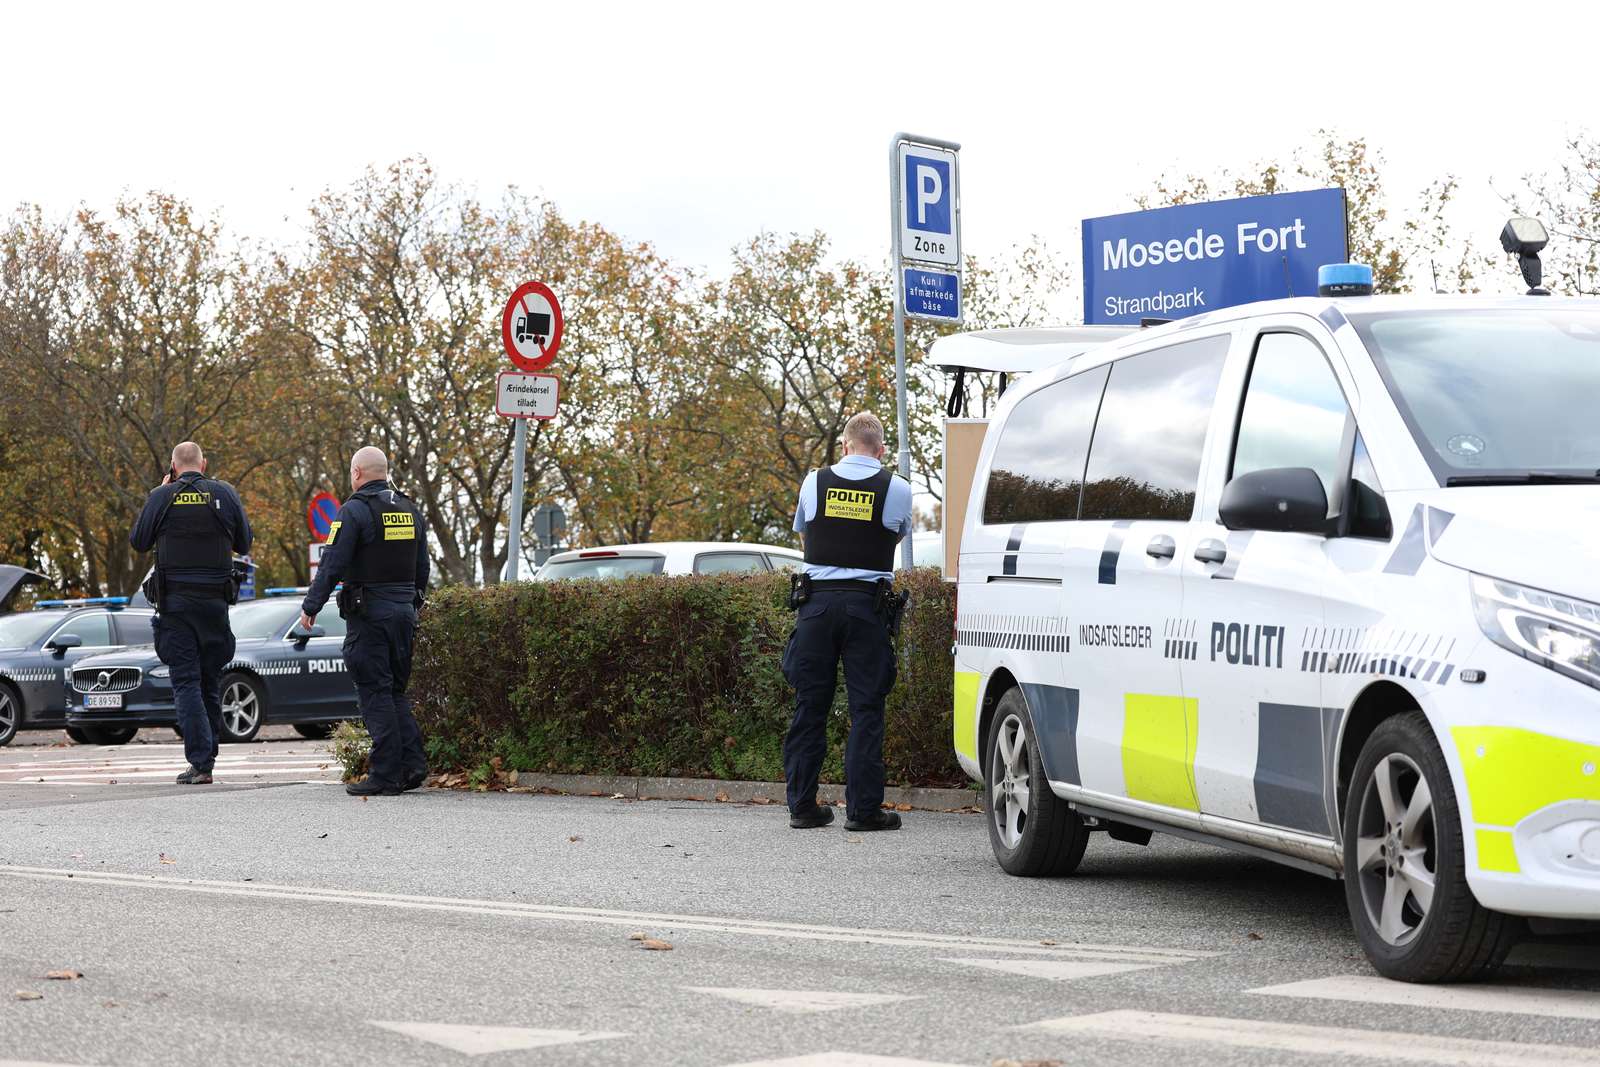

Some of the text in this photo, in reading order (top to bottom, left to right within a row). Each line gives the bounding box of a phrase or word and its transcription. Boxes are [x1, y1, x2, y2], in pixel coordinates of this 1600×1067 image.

[916, 164, 943, 224] P
[914, 236, 945, 254] Zone
[1103, 218, 1306, 271] Mosede Fort
[921, 275, 936, 286] Kun
[909, 287, 954, 301] afmærkede
[922, 300, 942, 311] båse
[1105, 287, 1206, 316] Strandpark
[506, 384, 550, 394] Ærindekørsel
[517, 399, 537, 407] tilladt
[828, 490, 873, 505] POLITI
[829, 504, 870, 513] INDSATSLEDER
[383, 514, 414, 523] POLITI
[1079, 624, 1152, 649] INDSATSLEDER
[1210, 621, 1285, 669] POLITI
